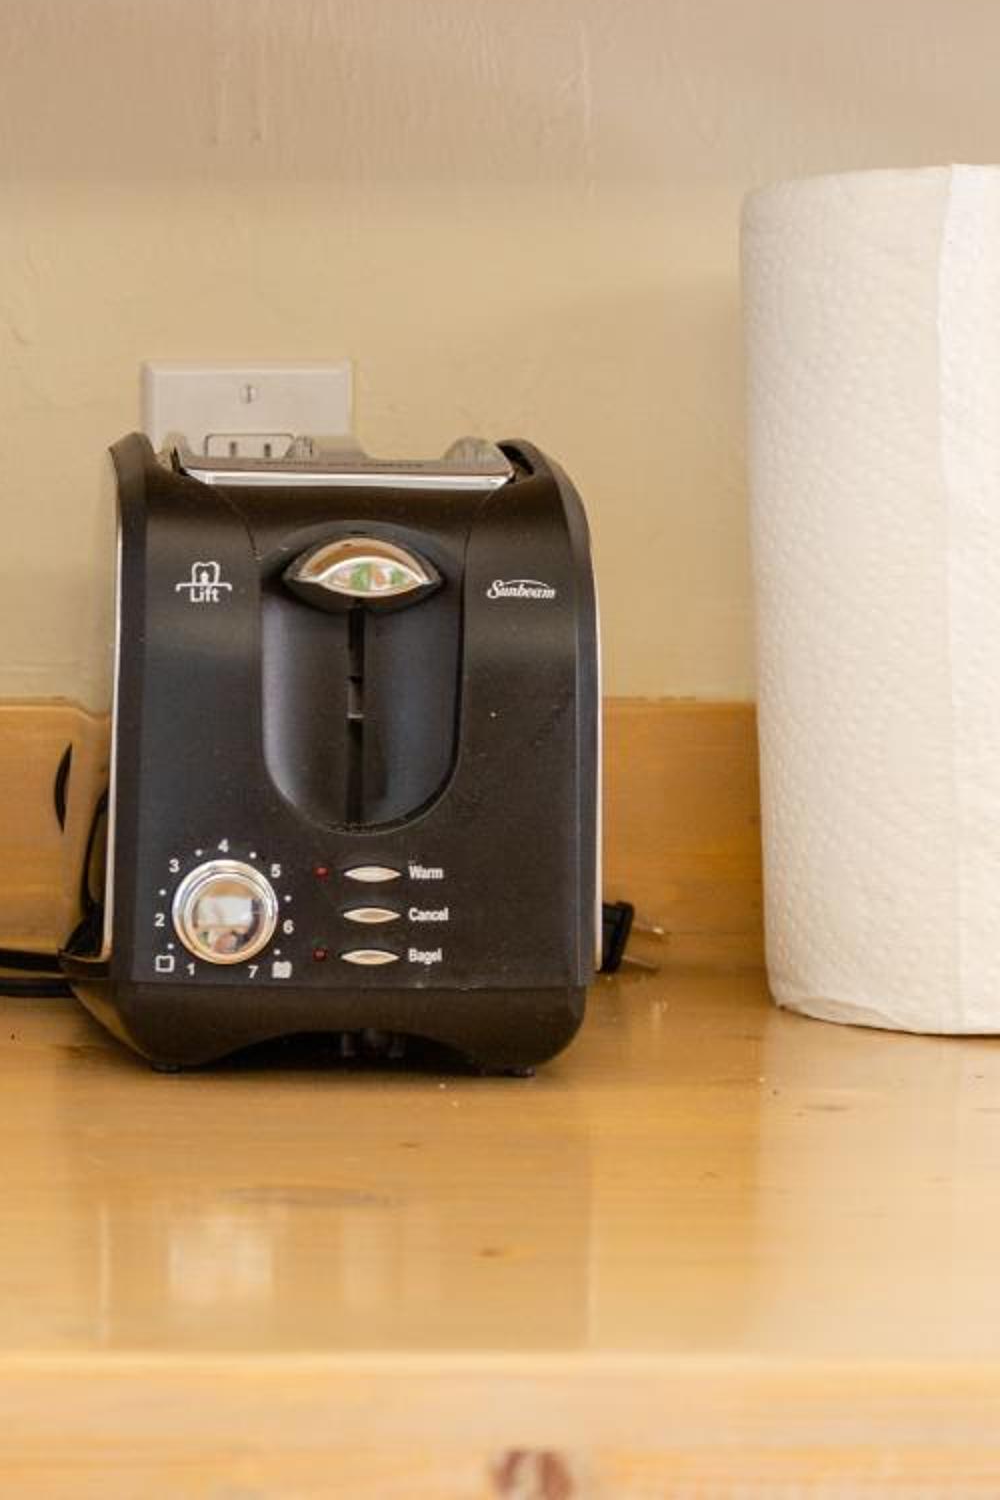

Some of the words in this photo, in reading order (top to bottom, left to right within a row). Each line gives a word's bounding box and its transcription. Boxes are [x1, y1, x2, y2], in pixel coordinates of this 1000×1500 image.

[189, 586, 220, 603] Lift
[486, 579, 556, 599] Sunbeam
[217, 838, 229, 852] 4
[169, 858, 180, 873] 3
[271, 864, 281, 878] 5
[408, 865, 444, 880] Warm
[154, 913, 165, 927] 2
[408, 907, 449, 921] Cancel
[283, 920, 294, 934] 6
[408, 947, 443, 965] Bagel
[187, 963, 195, 976] 1
[248, 965, 259, 978] 7
